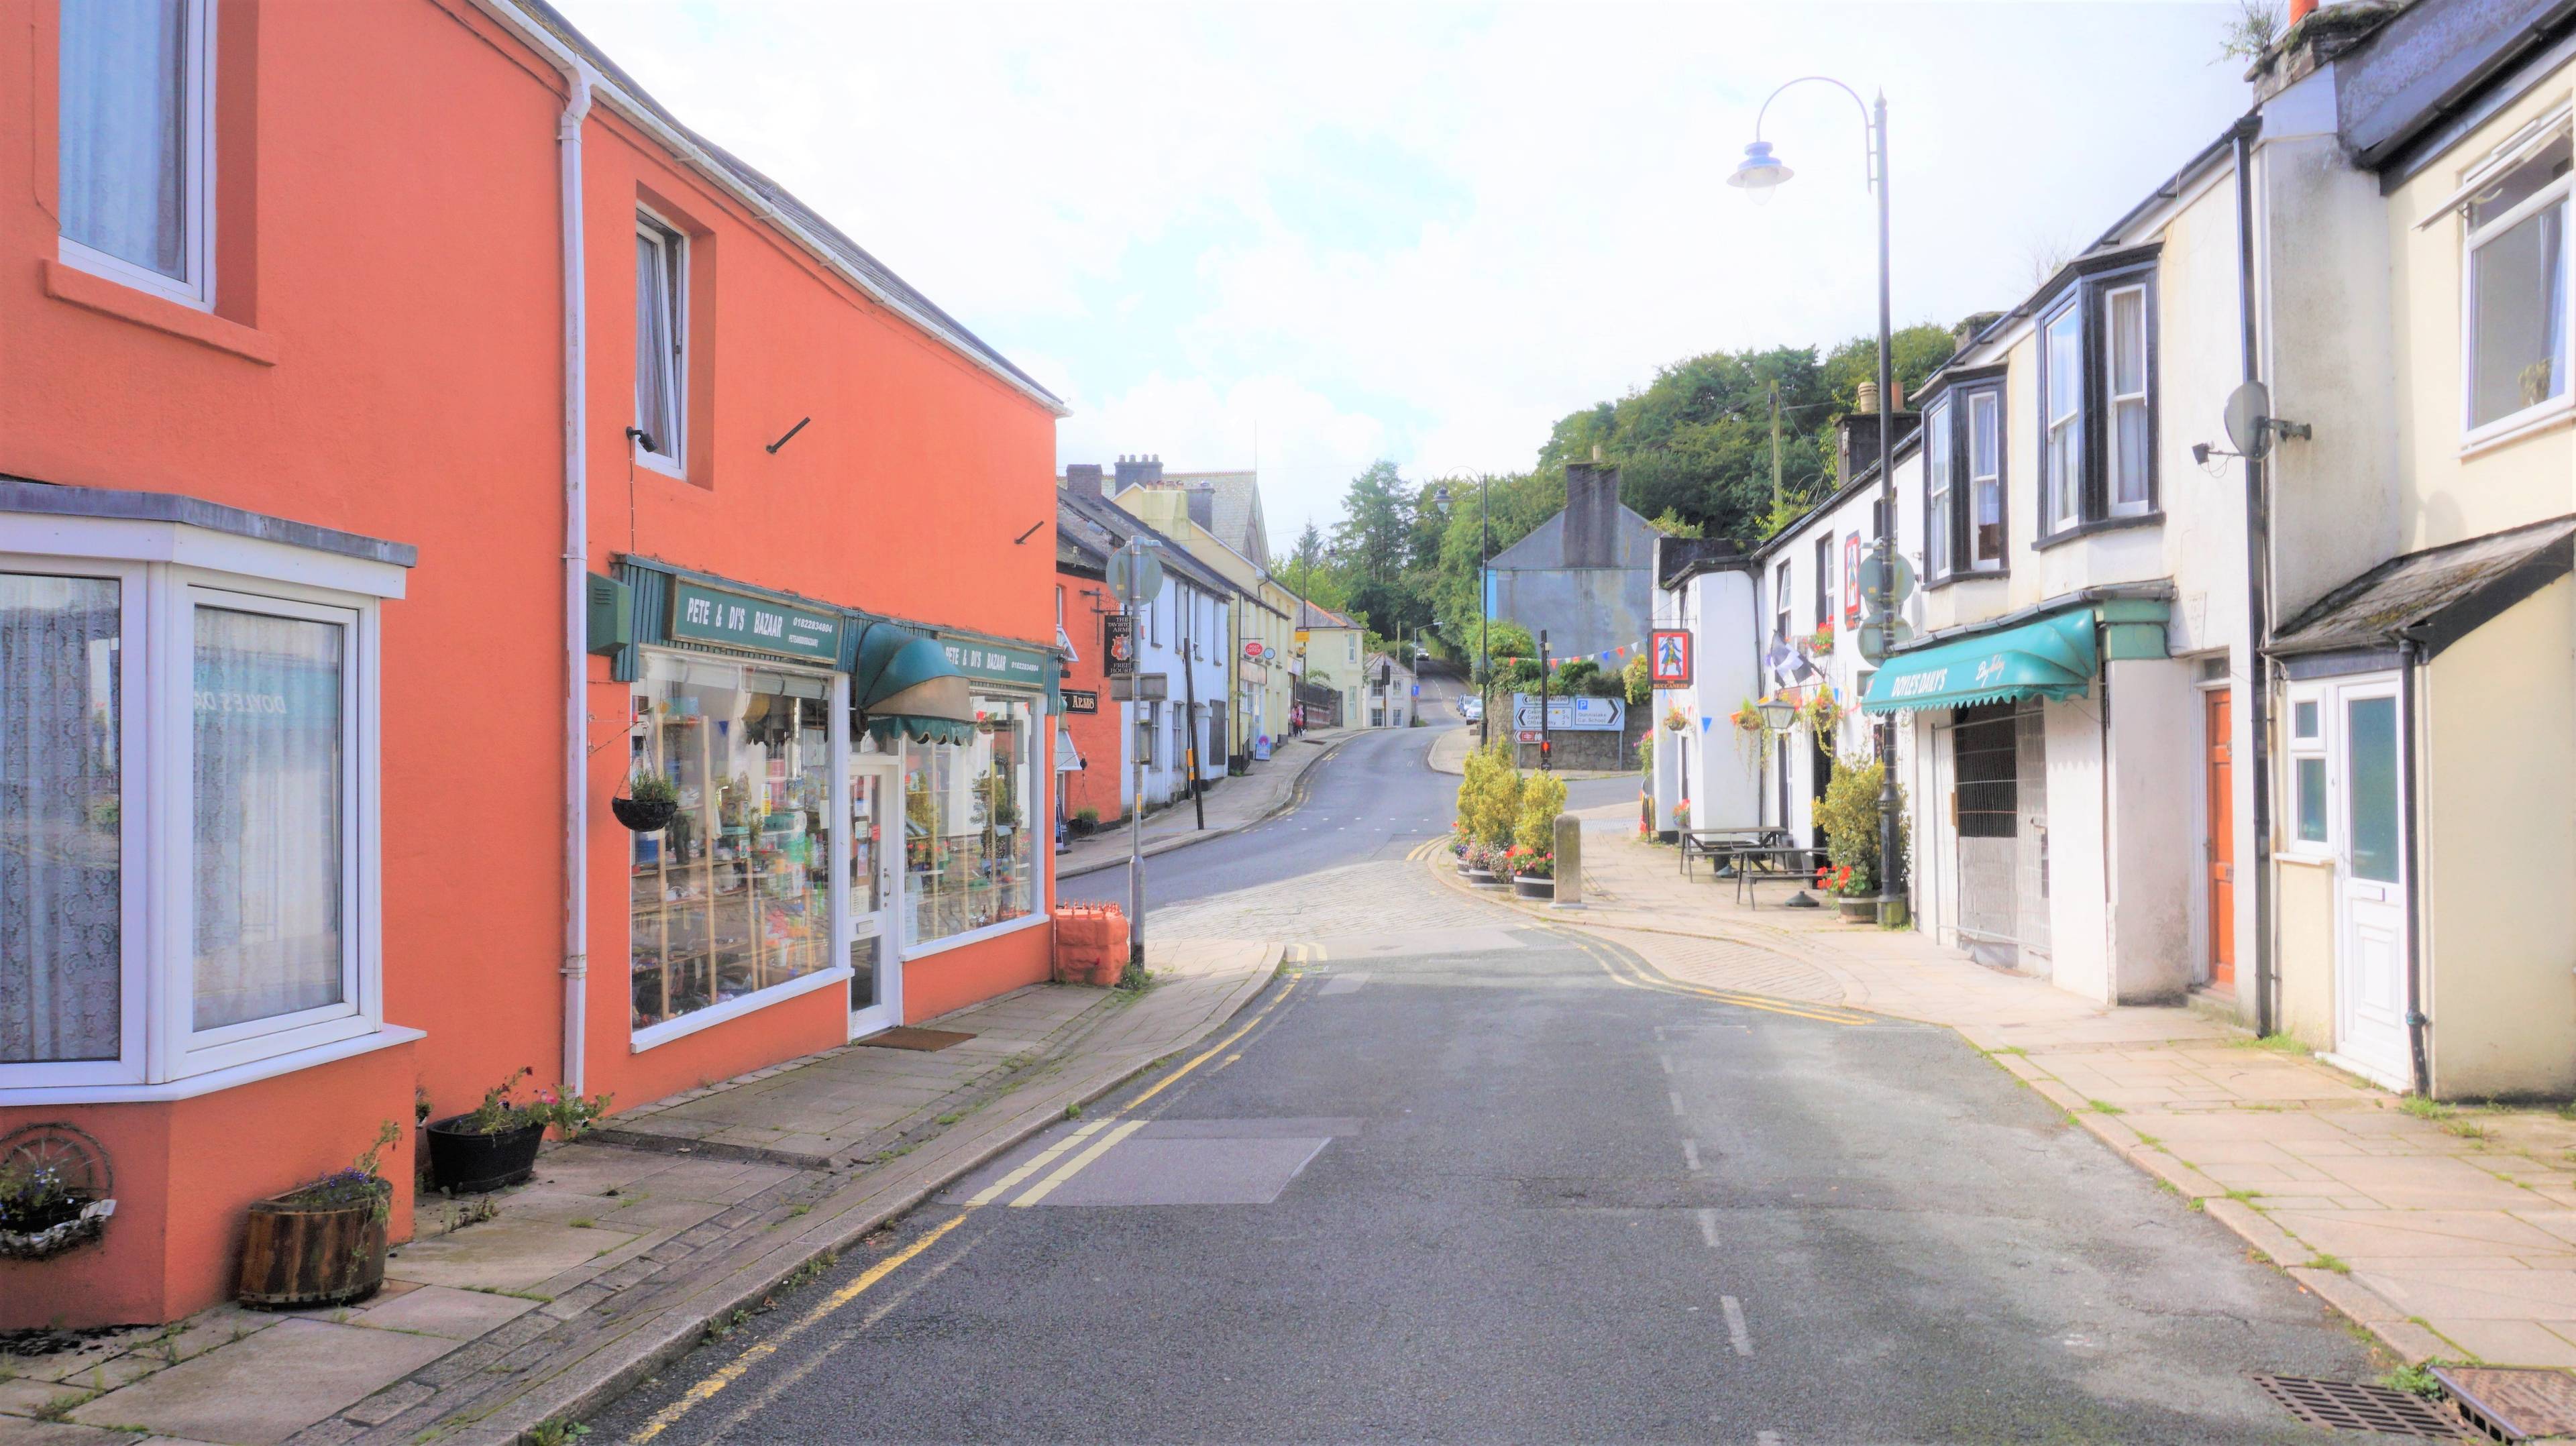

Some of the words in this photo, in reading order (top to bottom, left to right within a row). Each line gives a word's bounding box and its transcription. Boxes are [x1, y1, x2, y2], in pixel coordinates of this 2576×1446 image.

[687, 598, 710, 624] PETE
[716, 604, 722, 627] &
[729, 606, 745, 631] DI'S
[754, 611, 783, 638] BAZAAR
[793, 617, 833, 633] 01822834804
[963, 649, 967, 666] &
[971, 650, 981, 668] DI'S
[987, 653, 1006, 671] BAZAAR
[1891, 673, 1921, 697] DOYLE'S
[1918, 668, 1948, 694] DAILY'S
